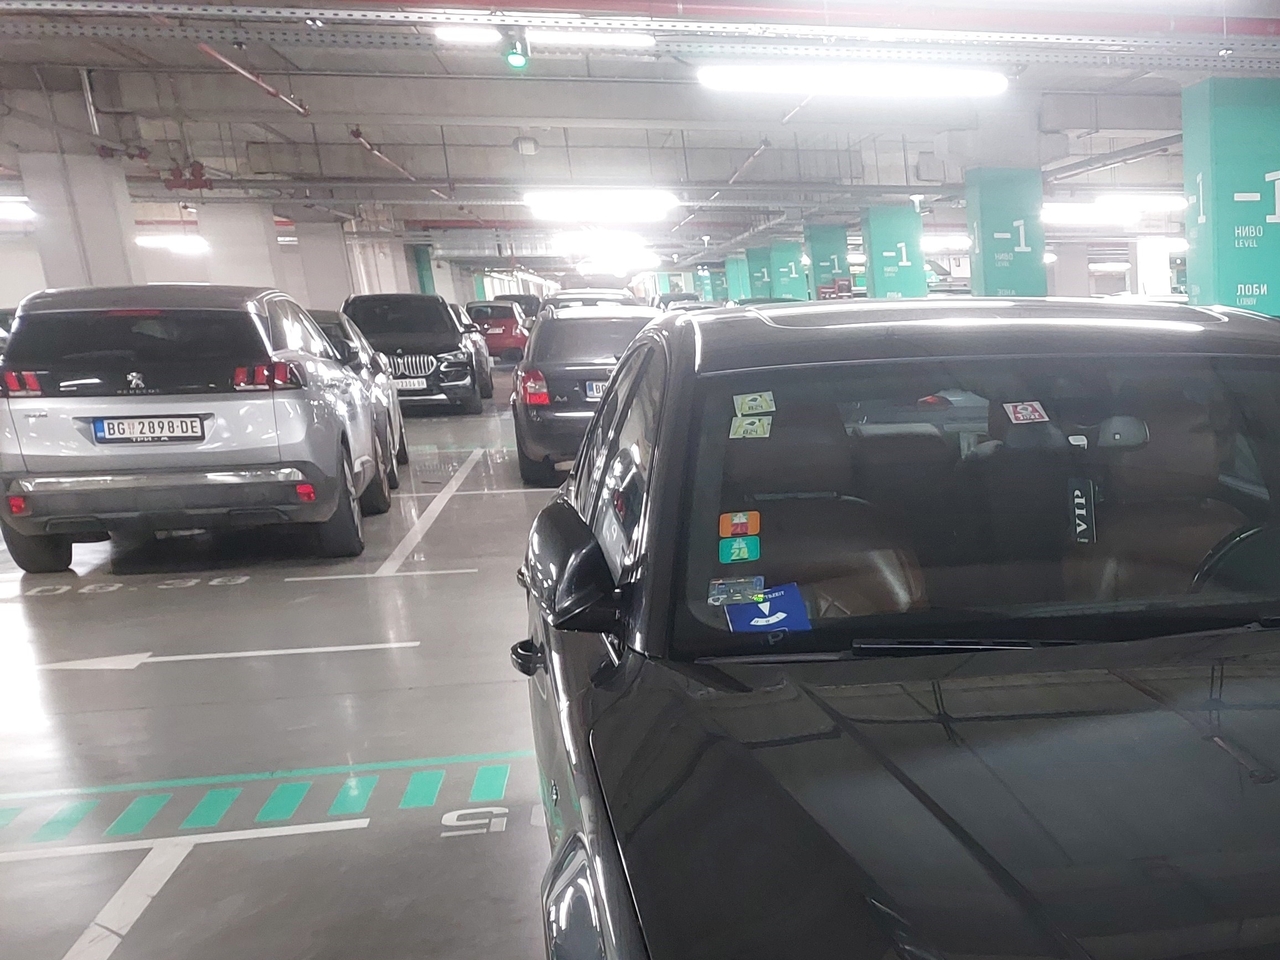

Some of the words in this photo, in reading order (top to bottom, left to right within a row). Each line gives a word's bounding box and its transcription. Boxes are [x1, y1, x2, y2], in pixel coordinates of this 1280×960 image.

[994, 219, 1032, 252] -1
[1234, 226, 1263, 237] НИВО
[1235, 239, 1258, 248] LEVEL
[883, 242, 912, 266] -1
[779, 262, 799, 278] -1
[819, 255, 842, 273] -1
[753, 267, 771, 282] -1
[1236, 284, 1268, 296] ЛОБИ
[107, 422, 126, 436] BG
[1073, 489, 1088, 534] VIP
